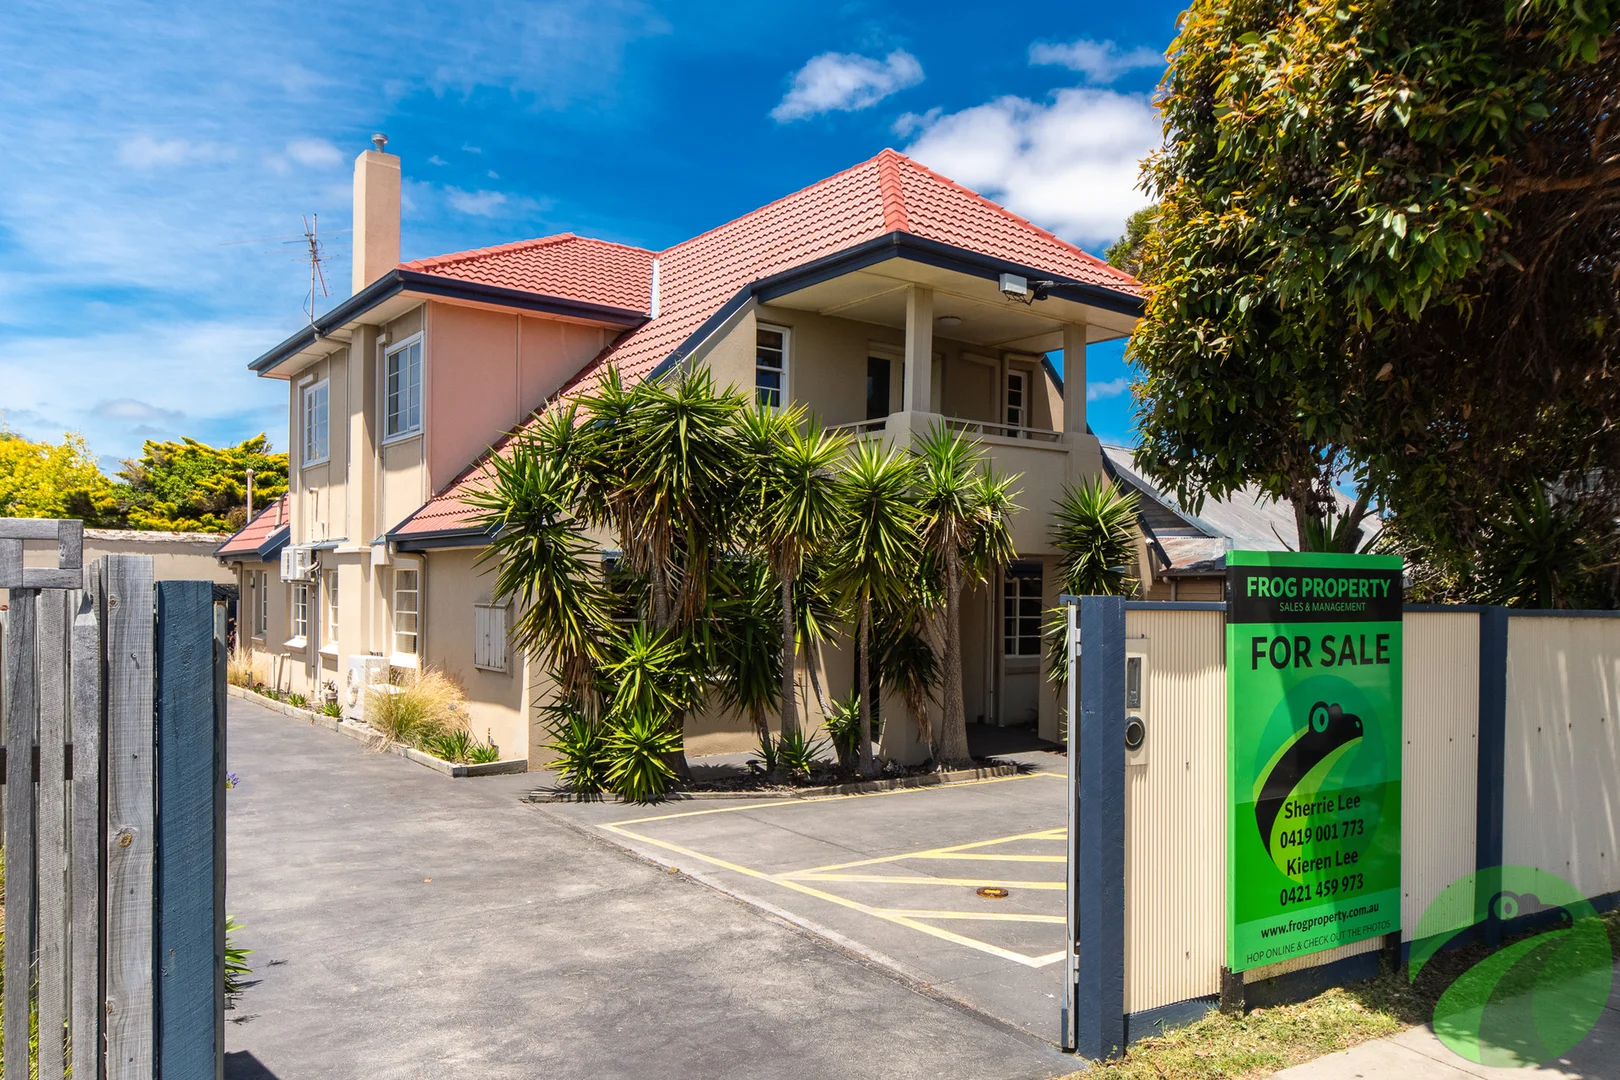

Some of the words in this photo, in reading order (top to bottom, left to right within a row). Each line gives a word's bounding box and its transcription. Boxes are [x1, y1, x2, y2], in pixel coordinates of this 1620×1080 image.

[1247, 576, 1297, 597] FROG
[1302, 578, 1391, 597] PROPERTY
[1280, 602, 1303, 612] SALES
[1305, 602, 1311, 612] &
[1312, 602, 1366, 612] MANAGEMENT
[1252, 636, 1313, 670] FOR
[1320, 634, 1390, 667] SALE
[1284, 797, 1334, 819] Sherrie
[1338, 795, 1361, 811] Lee
[1280, 828, 1312, 848] 0419
[1316, 824, 1338, 842] 001
[1342, 819, 1363, 840] 773
[1287, 856, 1332, 876] Kieren
[1336, 851, 1358, 867] Lee
[1280, 884, 1311, 906] 0421
[1316, 880, 1338, 898] 459
[1342, 873, 1363, 892] 973
[1261, 903, 1379, 938] www.frogproperty.com.au
[1247, 950, 1264, 964] HOP
[1266, 942, 1295, 959] ONLINE
[1297, 939, 1302, 951] &
[1304, 933, 1328, 949] CHECK
[1330, 930, 1346, 943] OUT
[1348, 926, 1361, 939] THE
[1363, 920, 1391, 935] PHOTOS
